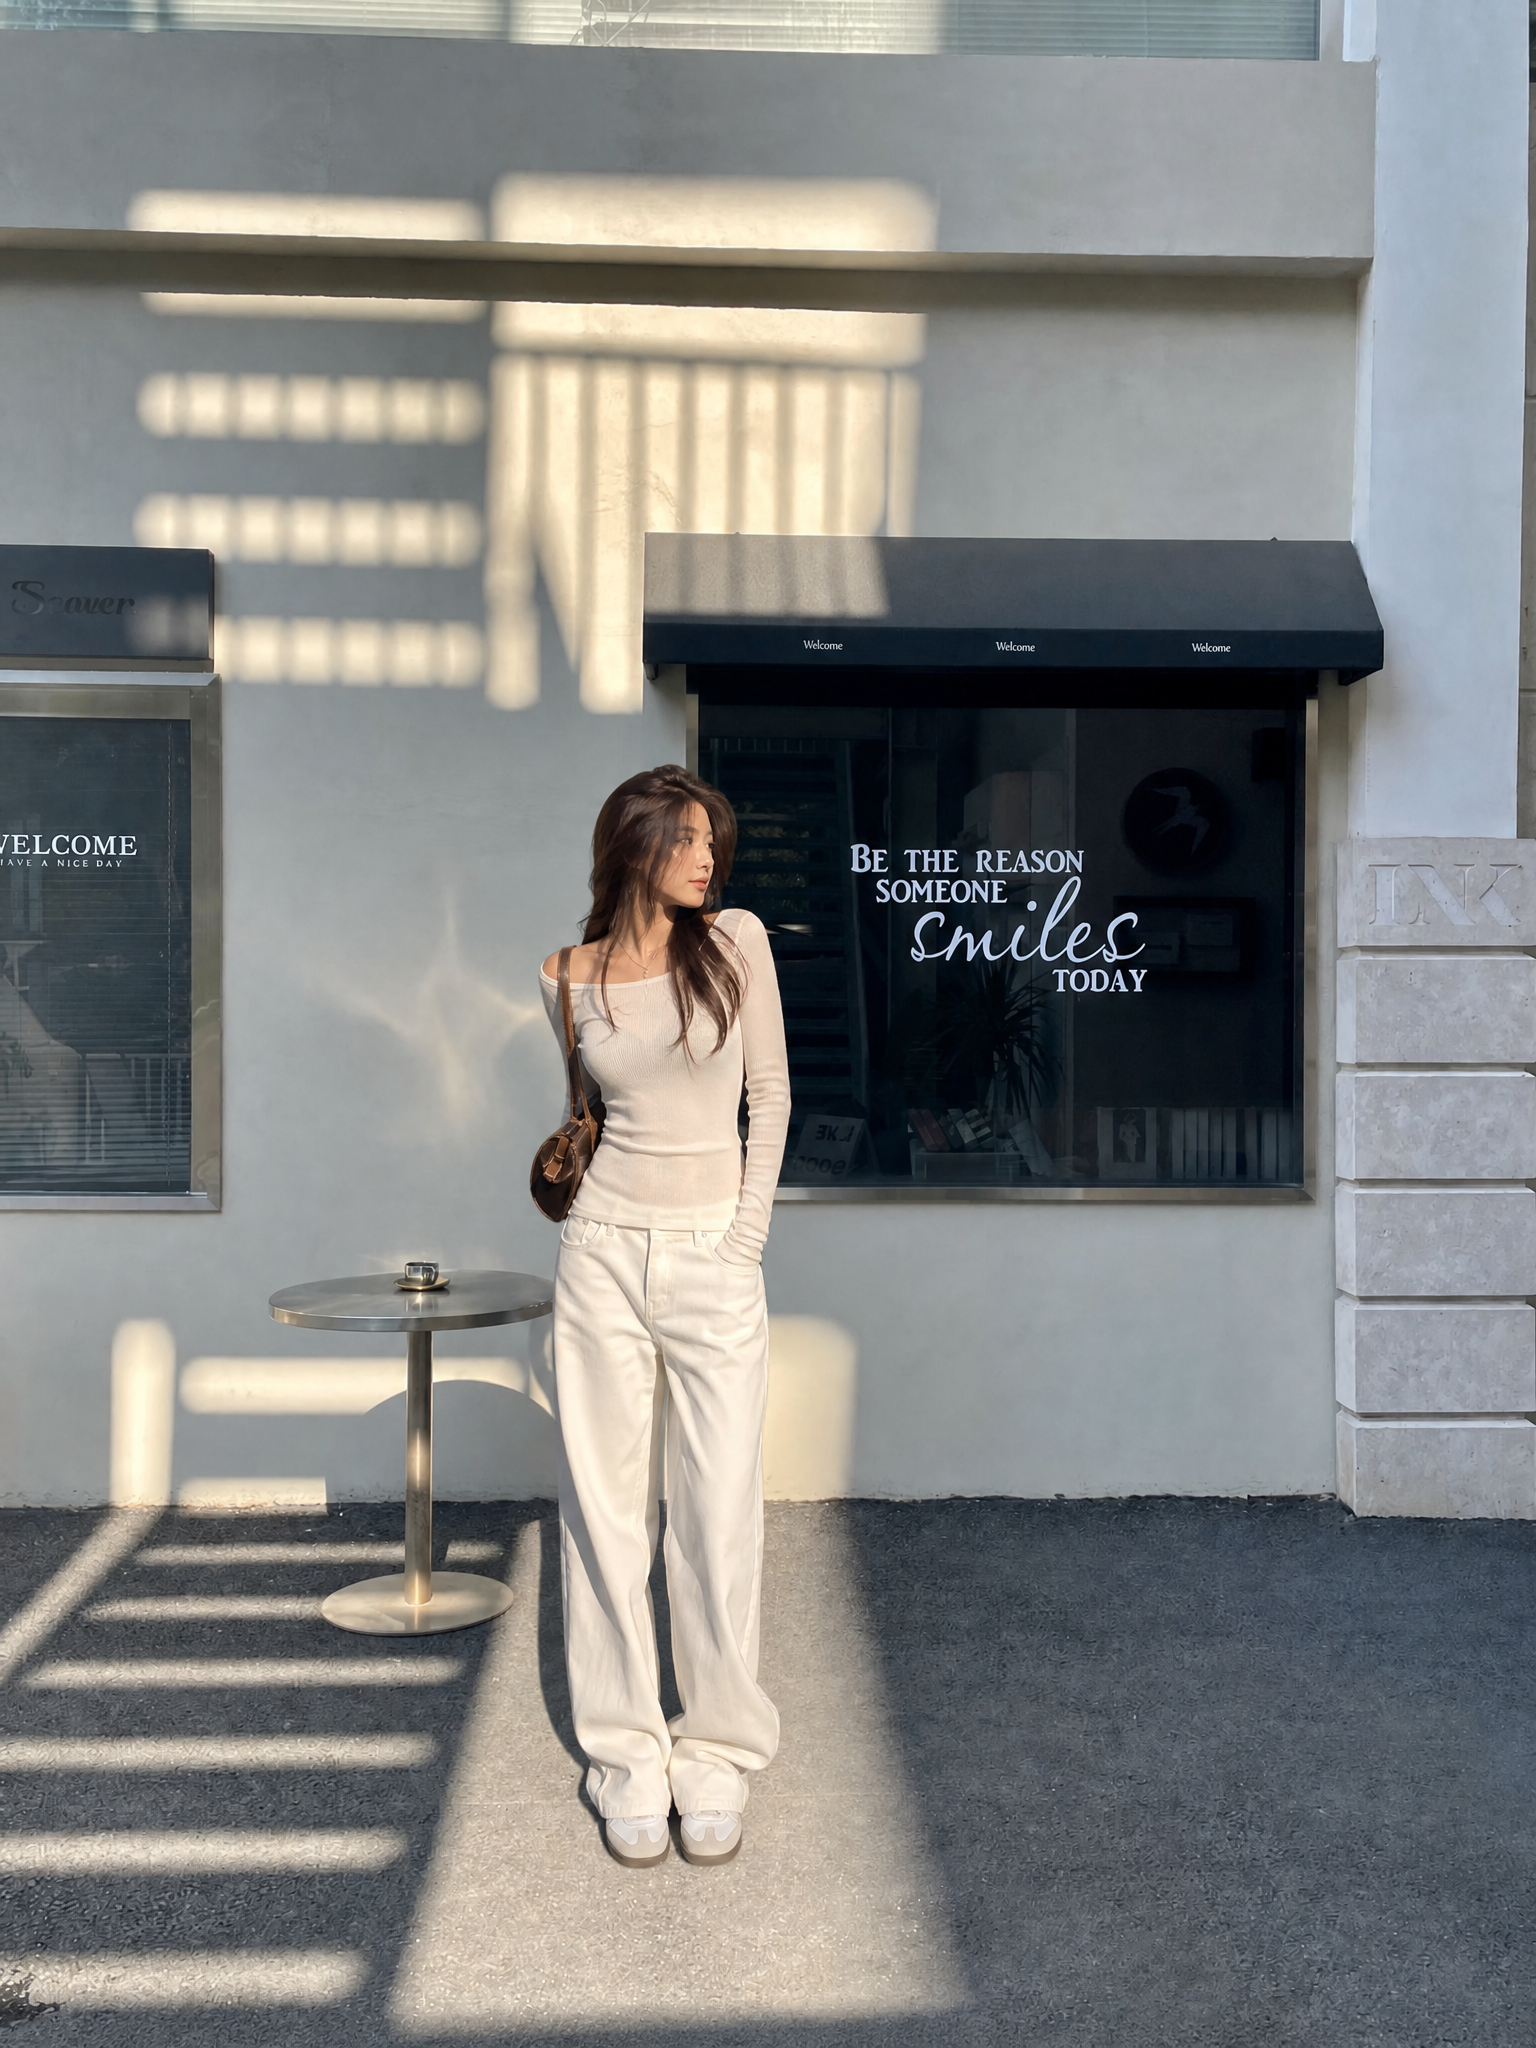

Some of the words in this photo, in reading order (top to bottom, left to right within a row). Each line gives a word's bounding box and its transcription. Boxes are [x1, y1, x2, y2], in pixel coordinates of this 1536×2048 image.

[803, 639, 844, 652] Welcome
[995, 641, 1036, 653] Welcome
[1191, 642, 1232, 653] Welcome
[41, 859, 49, 867] A
[57, 859, 89, 868] NICE
[96, 859, 123, 868] DAY
[903, 849, 960, 873] THE
[975, 849, 1085, 873] REASON
[875, 878, 1008, 904] SOMEONE
[1368, 863, 1522, 926] INK
[910, 875, 1146, 963] smiles
[1051, 968, 1148, 993] TODAY
